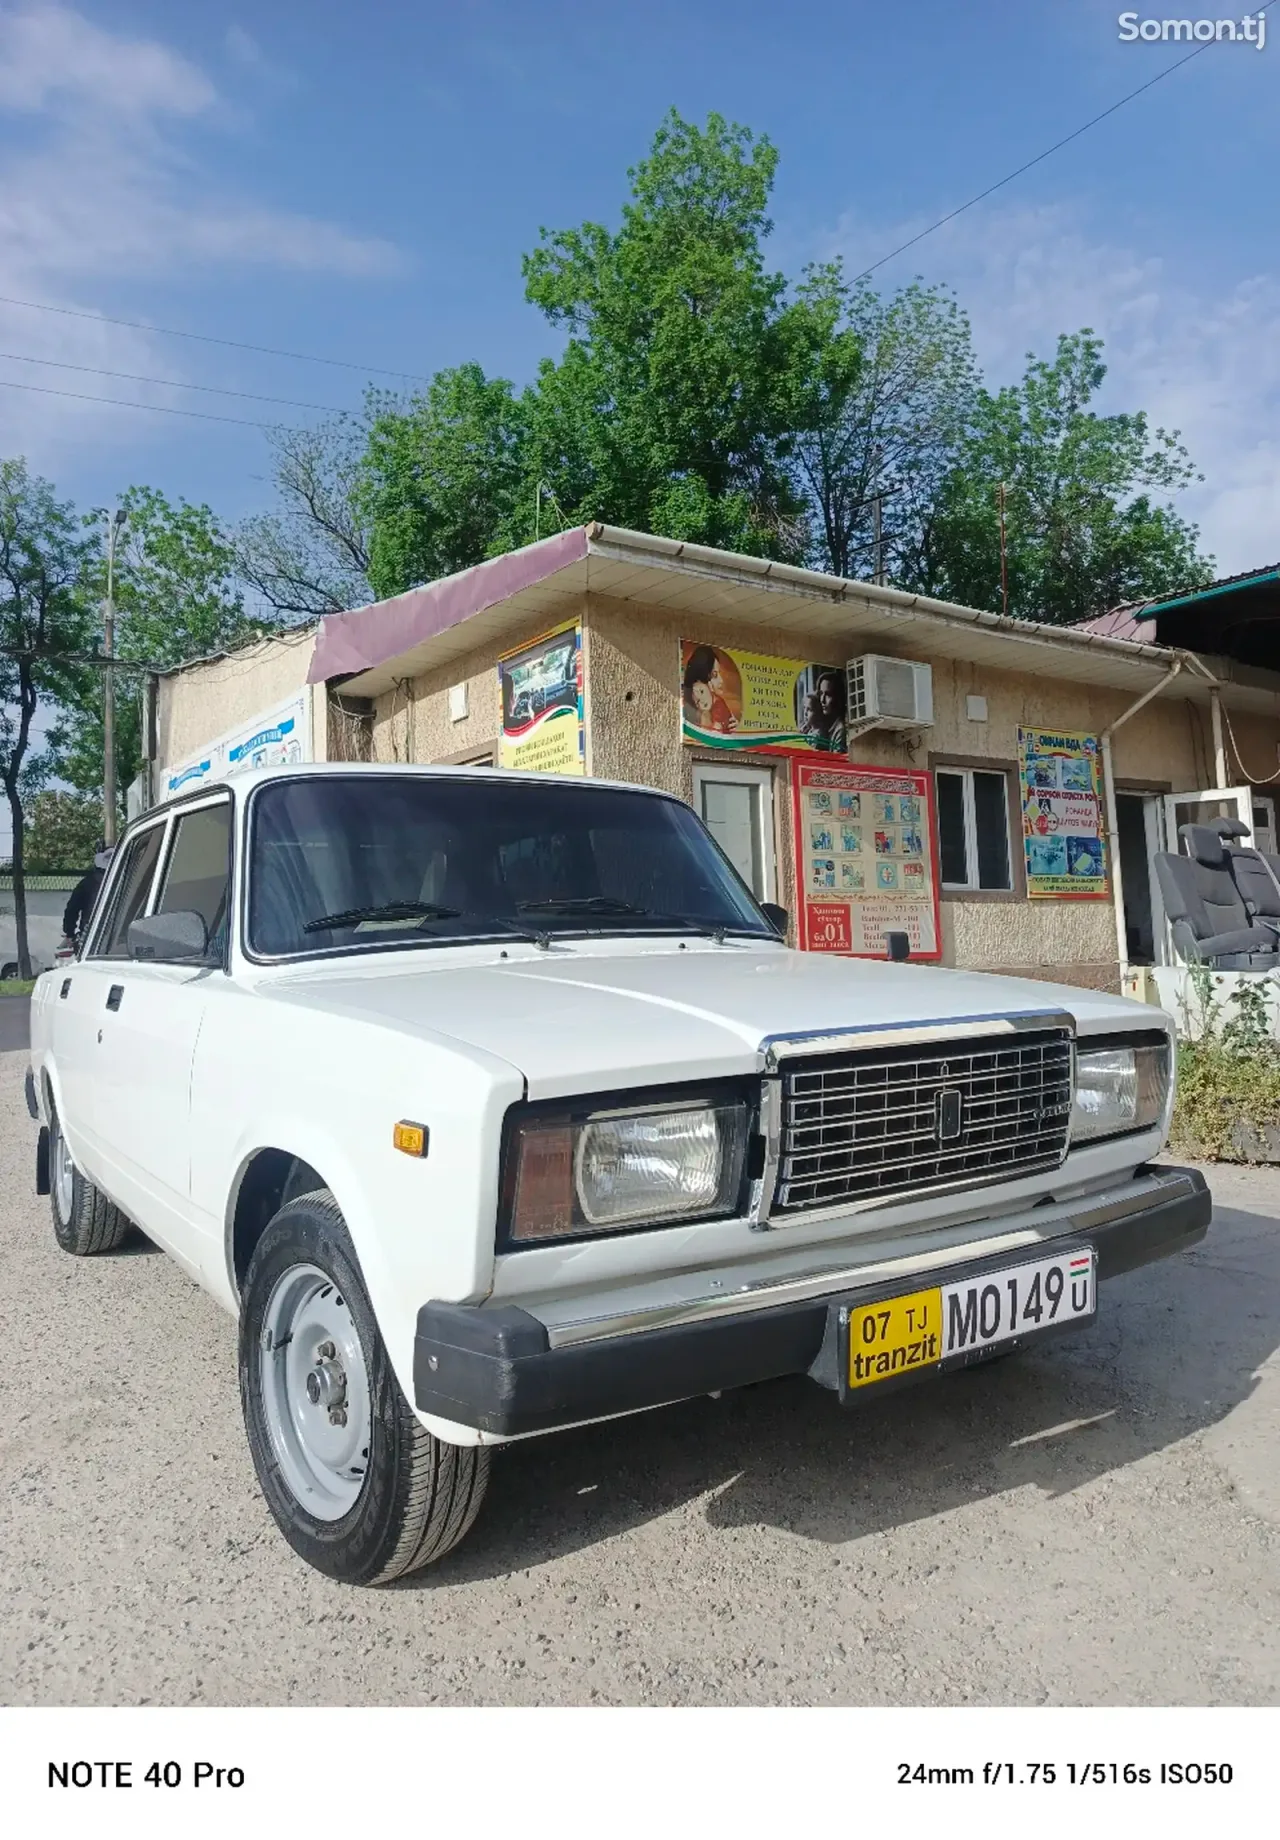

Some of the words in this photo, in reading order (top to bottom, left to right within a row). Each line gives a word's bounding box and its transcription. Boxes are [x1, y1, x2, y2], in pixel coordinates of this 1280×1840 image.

[1071, 1279, 1088, 1312] U
[862, 1310, 891, 1344] 07
[905, 1305, 928, 1334] TJ
[854, 1333, 937, 1380] tranzit
